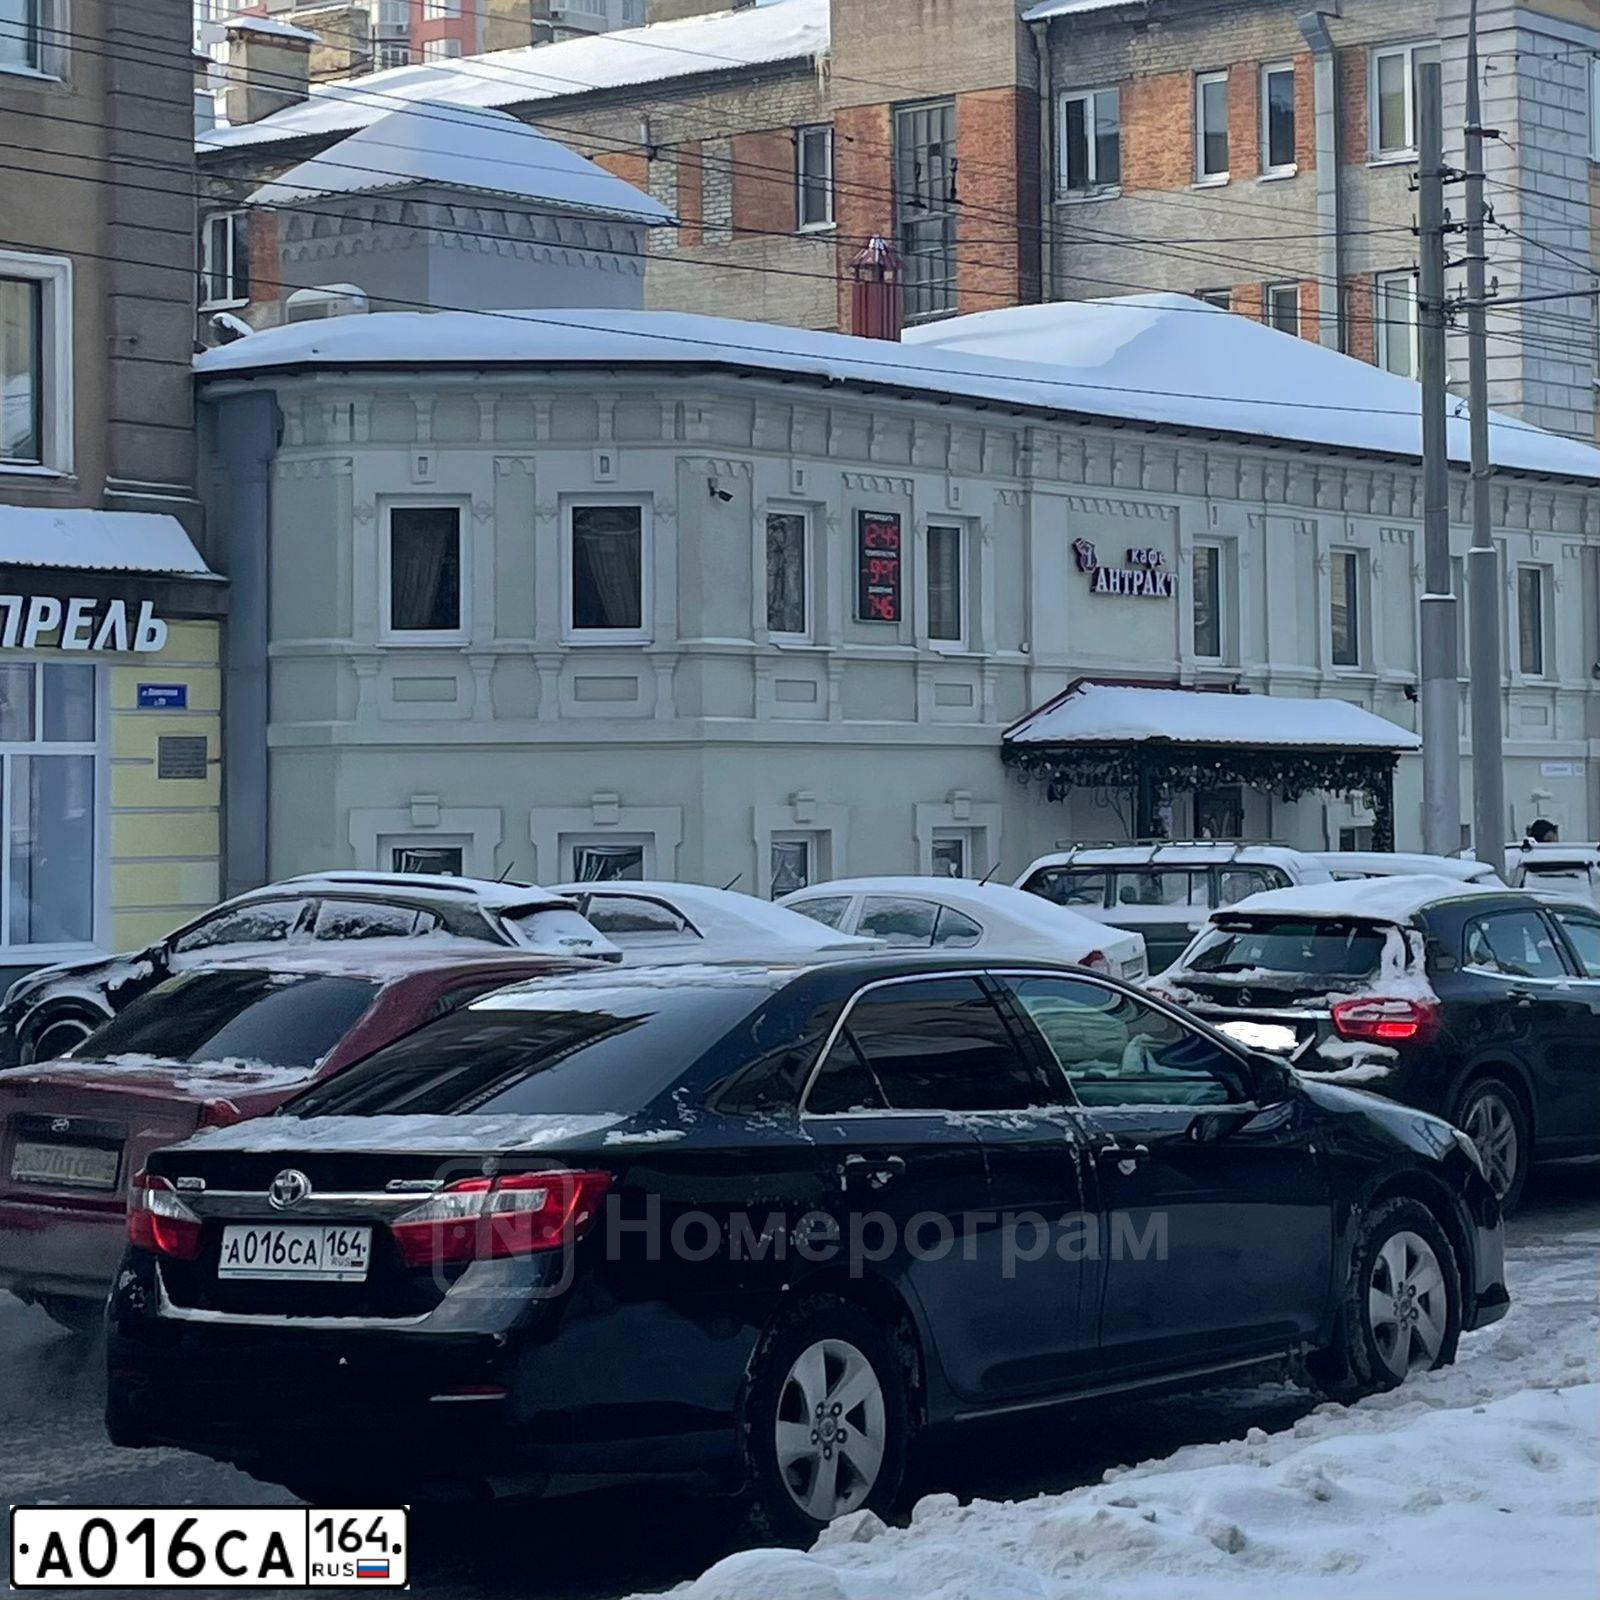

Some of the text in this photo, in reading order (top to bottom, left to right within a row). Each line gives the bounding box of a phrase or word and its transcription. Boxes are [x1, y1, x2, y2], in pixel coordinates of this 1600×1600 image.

[1095, 567, 1178, 597] АНТРАКТ
[227, 1230, 362, 1264] А016СА 164
[331, 1257, 351, 1266] RUS
